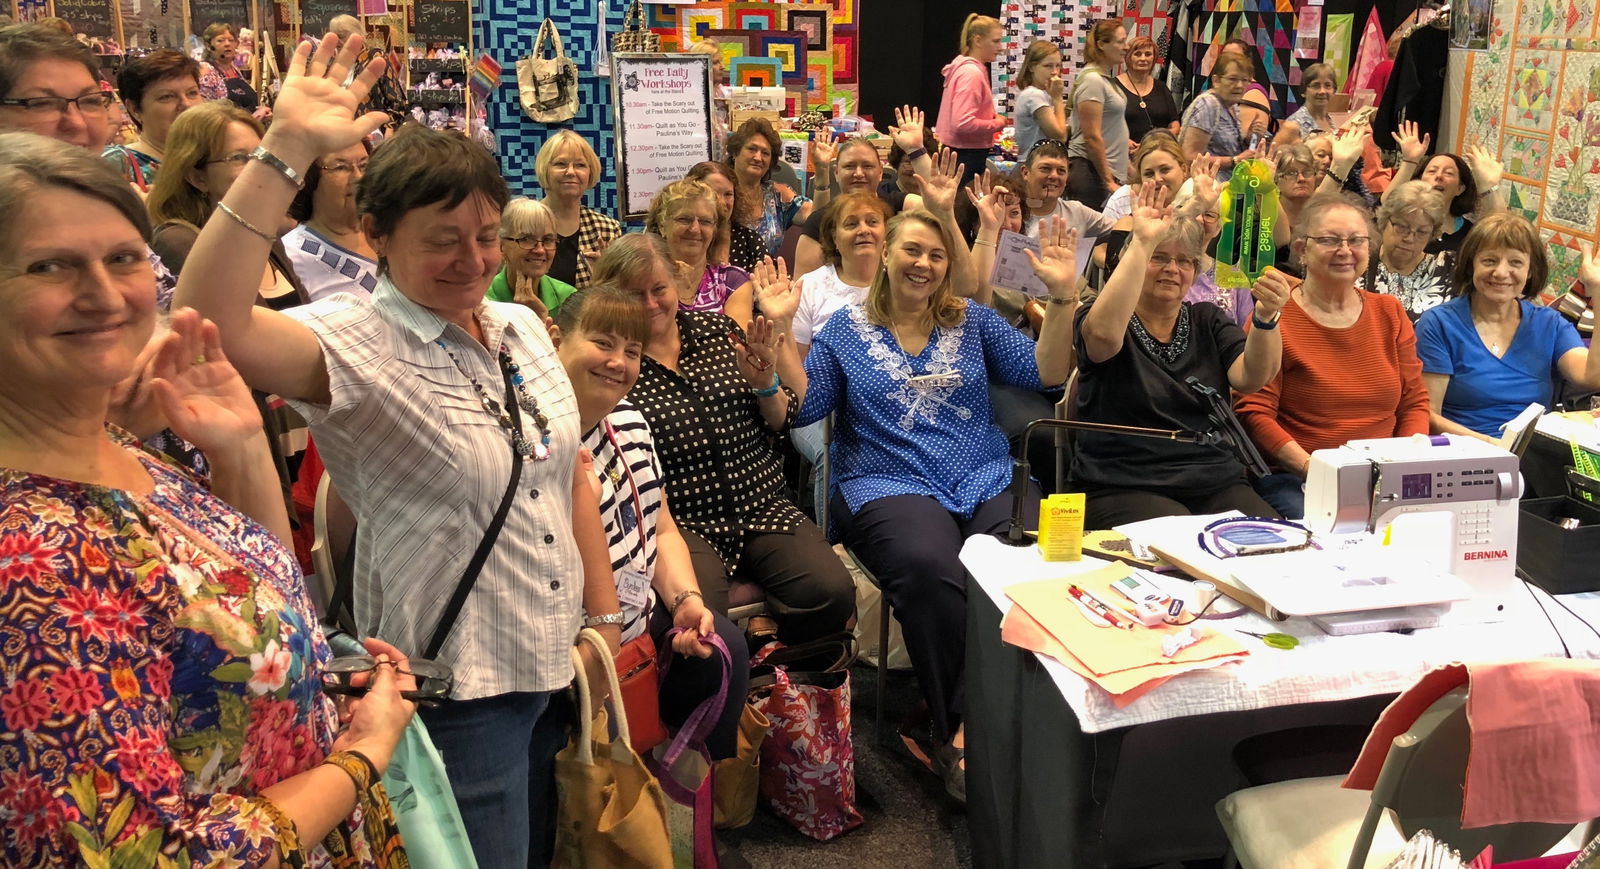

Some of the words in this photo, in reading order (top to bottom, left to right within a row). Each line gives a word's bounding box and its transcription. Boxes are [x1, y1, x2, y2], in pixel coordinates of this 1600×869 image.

[422, 4, 456, 15] Strips
[645, 68, 664, 77] Free
[668, 68, 688, 80] Daily
[640, 80, 692, 93] Workshops
[1464, 550, 1508, 560] BERNINA
